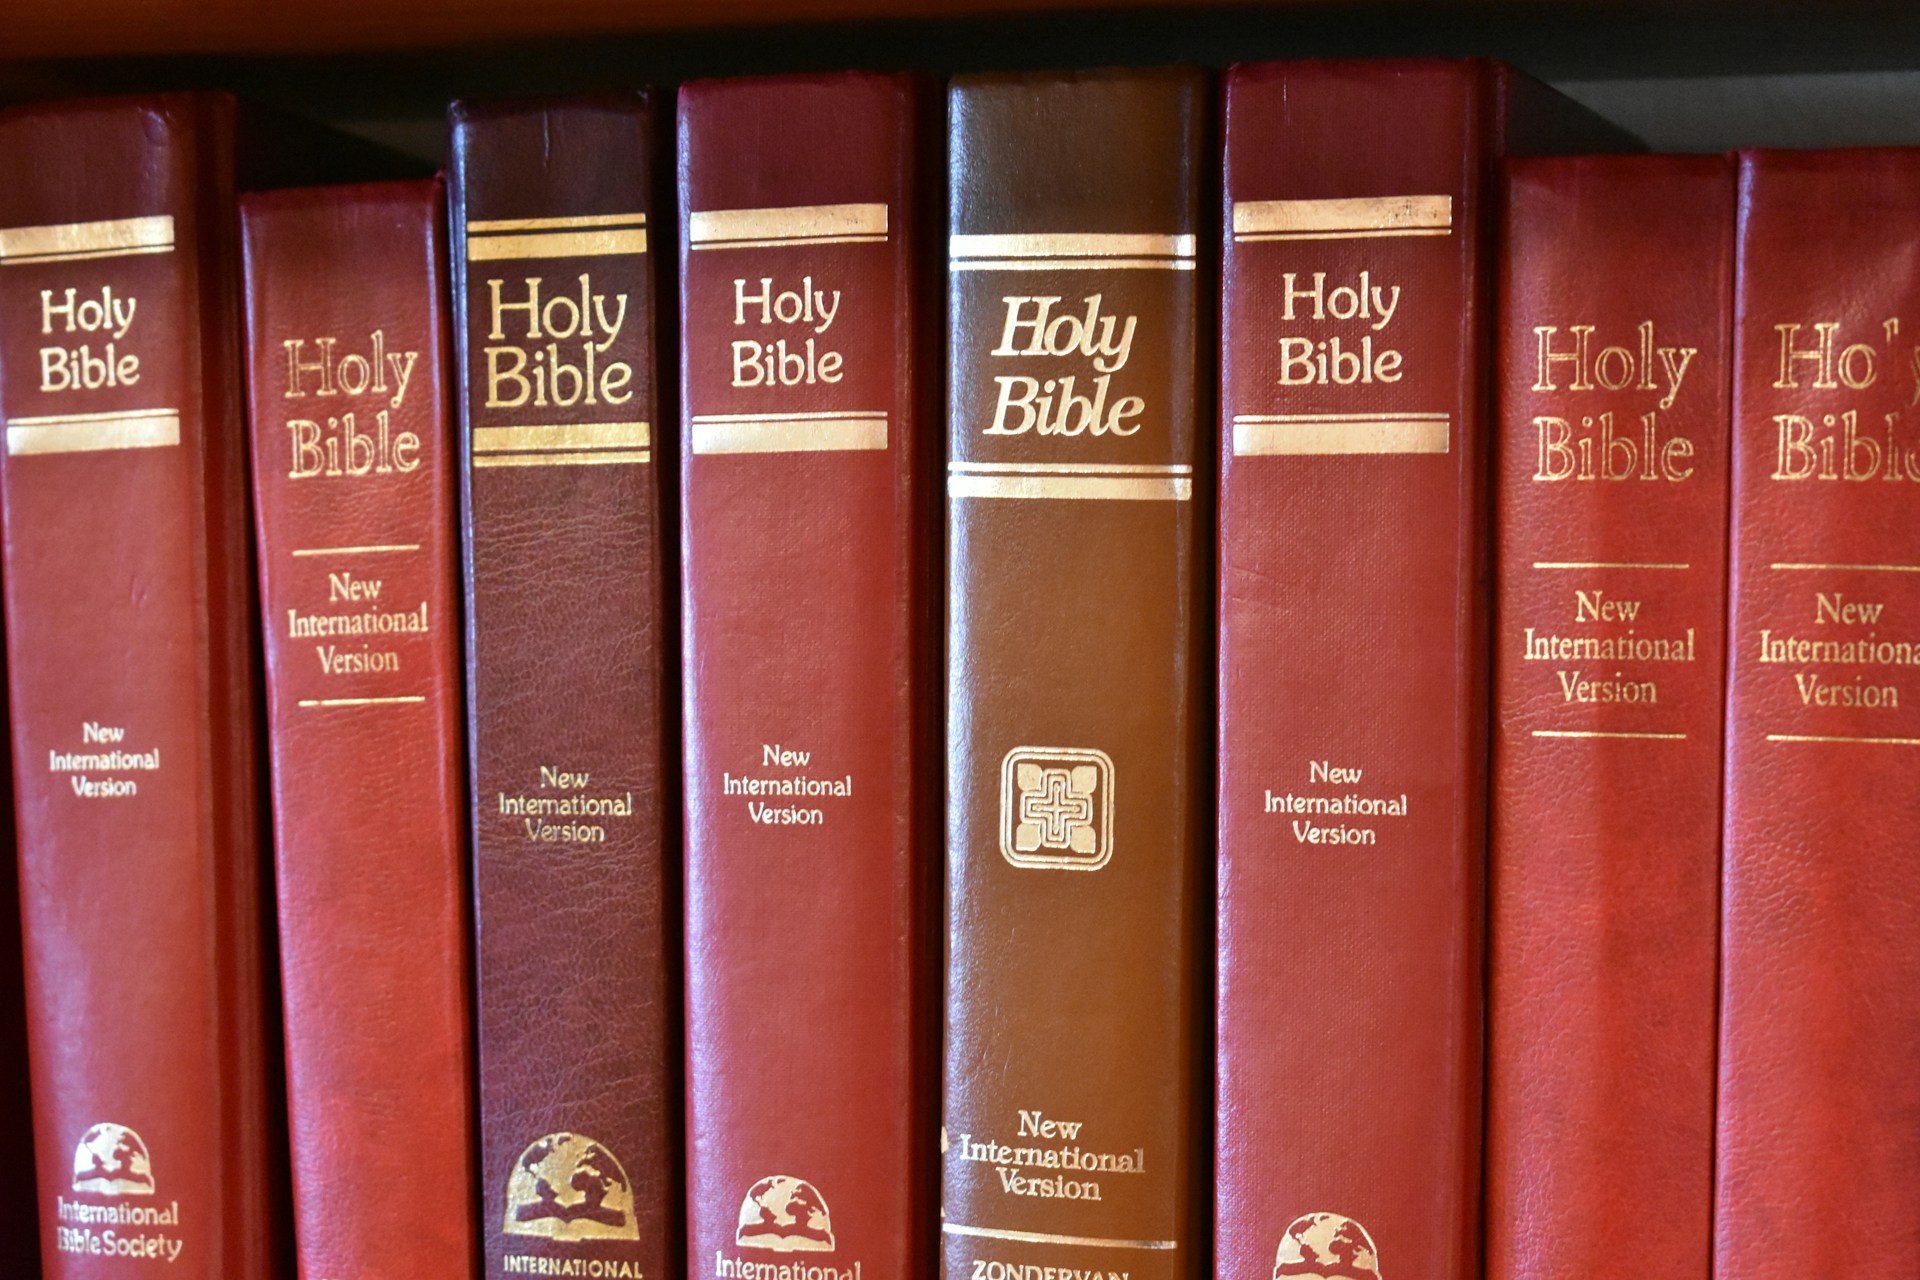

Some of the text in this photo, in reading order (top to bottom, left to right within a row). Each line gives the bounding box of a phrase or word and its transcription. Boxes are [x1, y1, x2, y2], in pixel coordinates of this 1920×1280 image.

[41, 286, 135, 339] Holy
[485, 274, 627, 352] Holy
[734, 276, 840, 332] Holy
[1282, 271, 1400, 330] Holy
[991, 294, 1136, 372] Holy
[40, 344, 139, 391] Bible
[283, 330, 418, 409] Holy
[484, 341, 632, 407] Bible
[732, 339, 843, 387] Bible
[1278, 336, 1402, 385] Bible
[1531, 321, 1697, 409] Holy
[983, 374, 1144, 436] Bible
[287, 410, 419, 479] Bible
[1532, 412, 1693, 483] Bible
[329, 573, 381, 601] New
[288, 602, 428, 637] International
[1575, 591, 1639, 622] New
[1815, 593, 1883, 624] New
[317, 644, 398, 673] Version
[1524, 628, 1693, 660] International
[1557, 671, 1655, 702] Version
[1795, 673, 1897, 706] Version
[84, 723, 123, 742] New
[51, 750, 158, 769] International
[763, 745, 810, 767] New
[72, 776, 136, 796] Version
[541, 766, 589, 789] New
[724, 773, 851, 796] International
[1310, 761, 1362, 784] New
[500, 792, 631, 816] International
[748, 802, 823, 824] Version
[1265, 790, 1406, 815] International
[525, 818, 604, 842] Version
[1293, 821, 1375, 844] Version
[1018, 1110, 1082, 1140] New
[959, 1133, 1145, 1174] International
[996, 1166, 1104, 1200] Version
[59, 1194, 177, 1224] International
[57, 1226, 182, 1261] Bible Society
[504, 1255, 642, 1278] INTERNATIONAL
